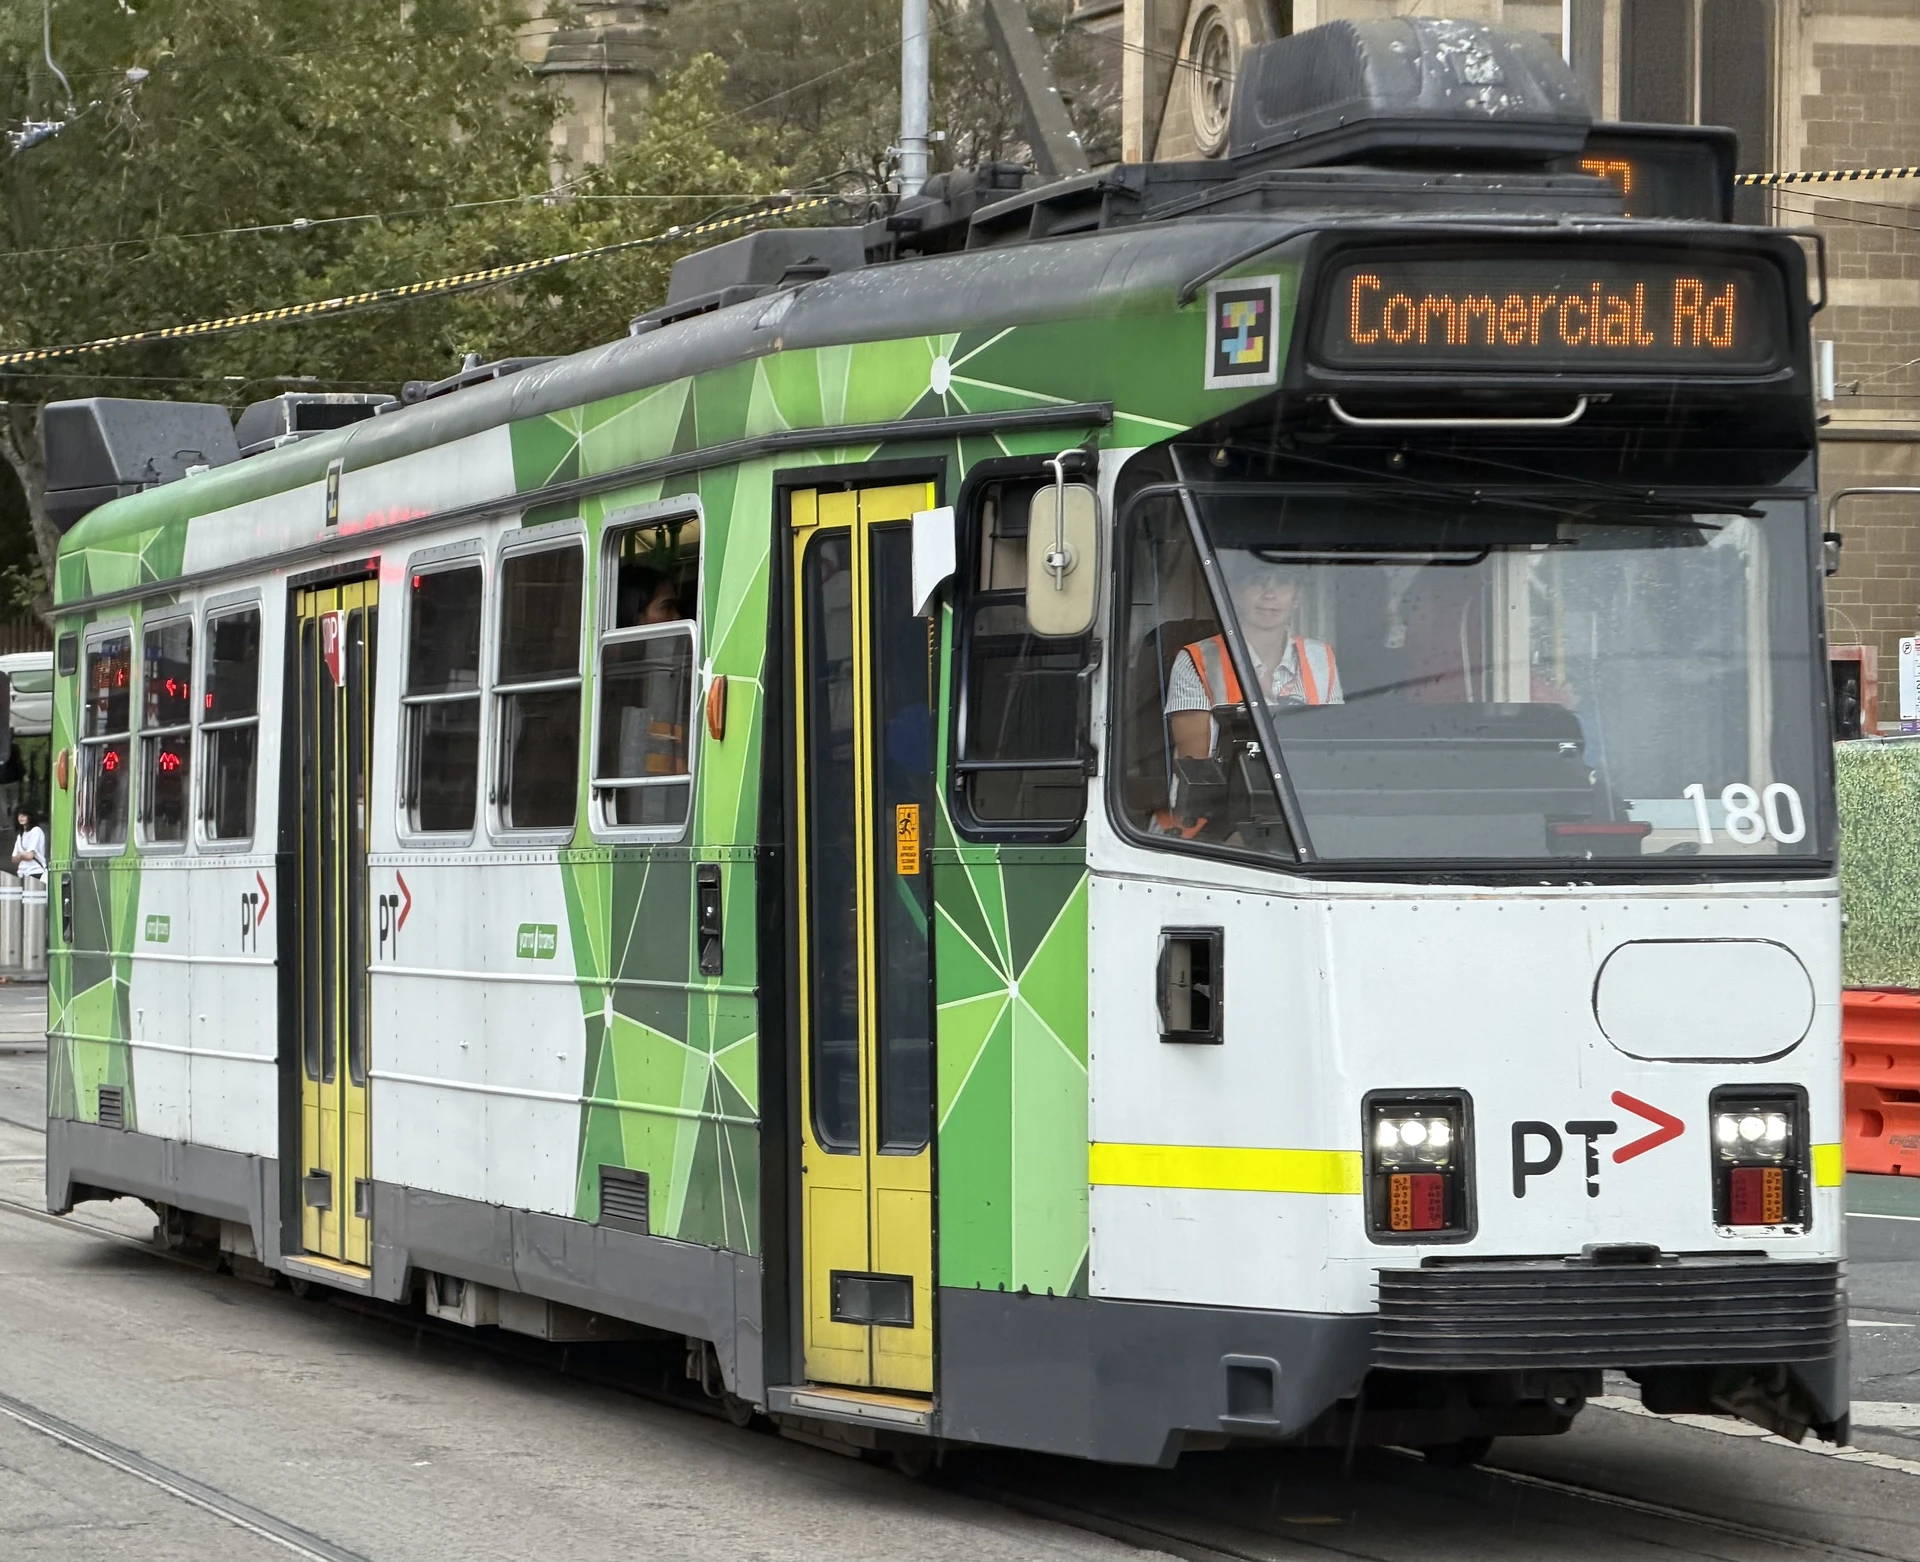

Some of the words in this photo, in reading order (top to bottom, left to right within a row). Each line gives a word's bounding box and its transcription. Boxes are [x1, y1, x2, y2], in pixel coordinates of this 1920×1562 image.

[1350, 273, 1655, 347] Commercial
[1673, 277, 1735, 348] Rd
[1683, 782, 1806, 844] 180
[241, 892, 259, 953] PT
[379, 894, 399, 961] PT
[1511, 1120, 1618, 1199] PT
